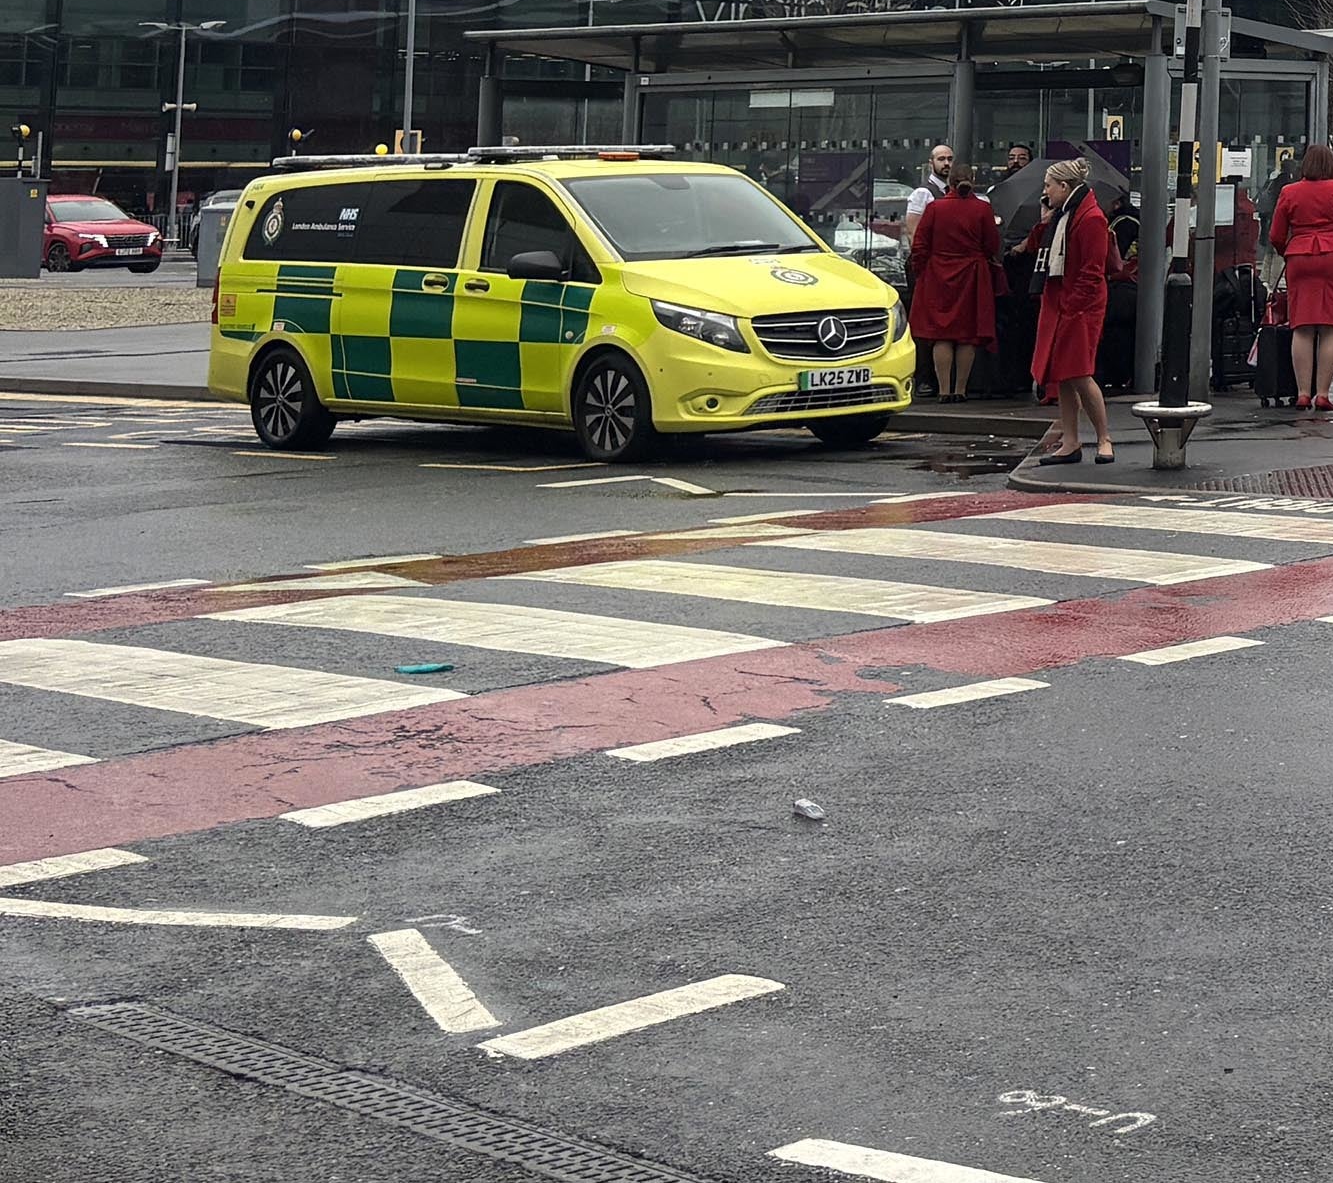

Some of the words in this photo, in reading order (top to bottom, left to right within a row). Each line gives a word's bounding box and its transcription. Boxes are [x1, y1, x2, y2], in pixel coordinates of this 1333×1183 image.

[339, 208, 359, 220] NHS
[310, 222, 337, 231] Ambulance
[337, 223, 356, 231] Service
[1033, 248, 1050, 272] H
[810, 371, 844, 387] LK25
